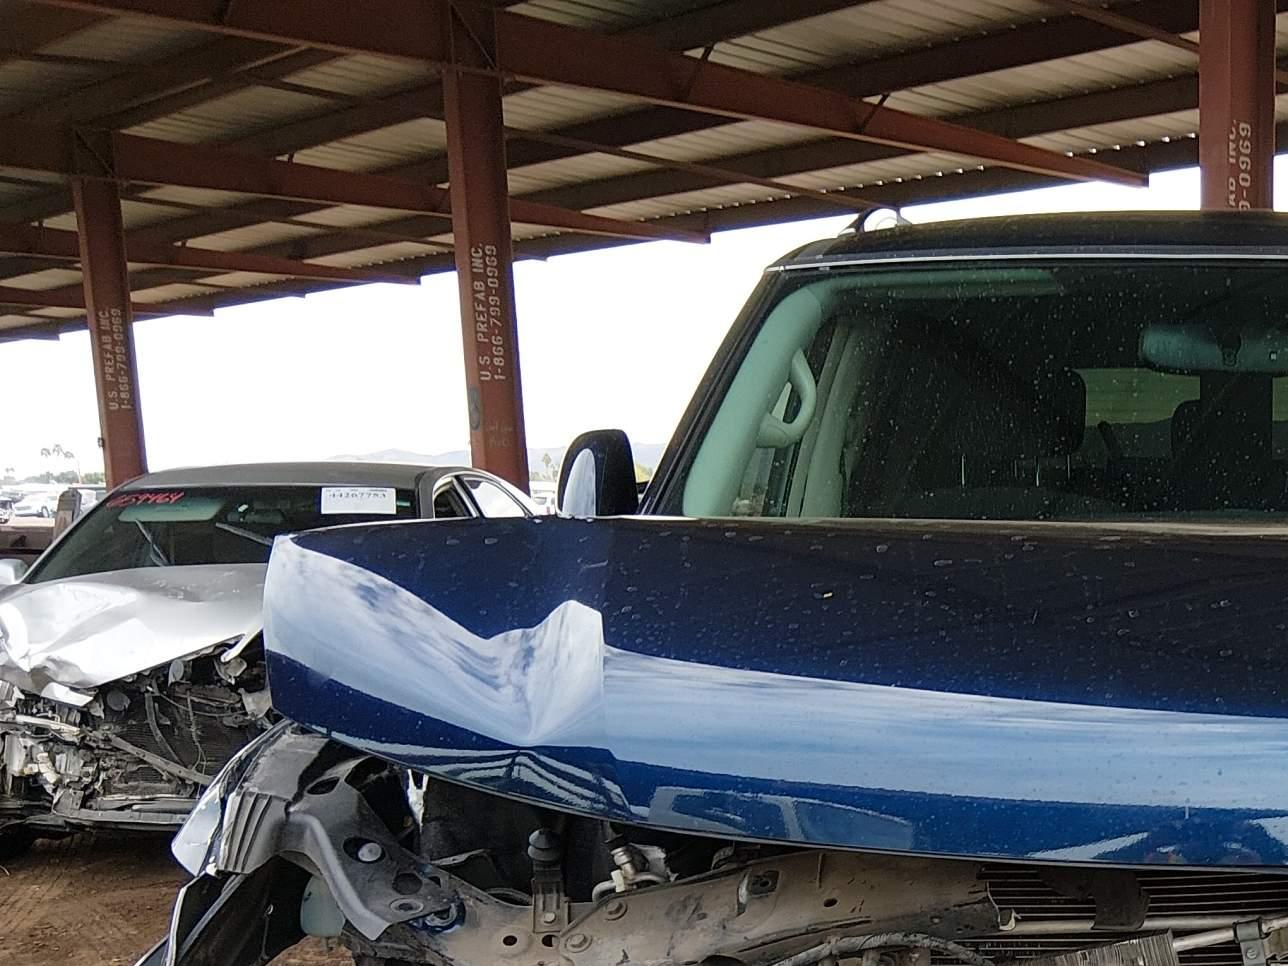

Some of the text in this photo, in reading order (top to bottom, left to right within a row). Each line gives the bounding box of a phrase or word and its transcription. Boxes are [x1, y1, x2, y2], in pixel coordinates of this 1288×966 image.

[471, 243, 484, 273] INC.
[473, 280, 489, 343] PREFAB
[484, 244, 506, 381] 1-866-799-0969
[101, 335, 117, 382] PREFAB
